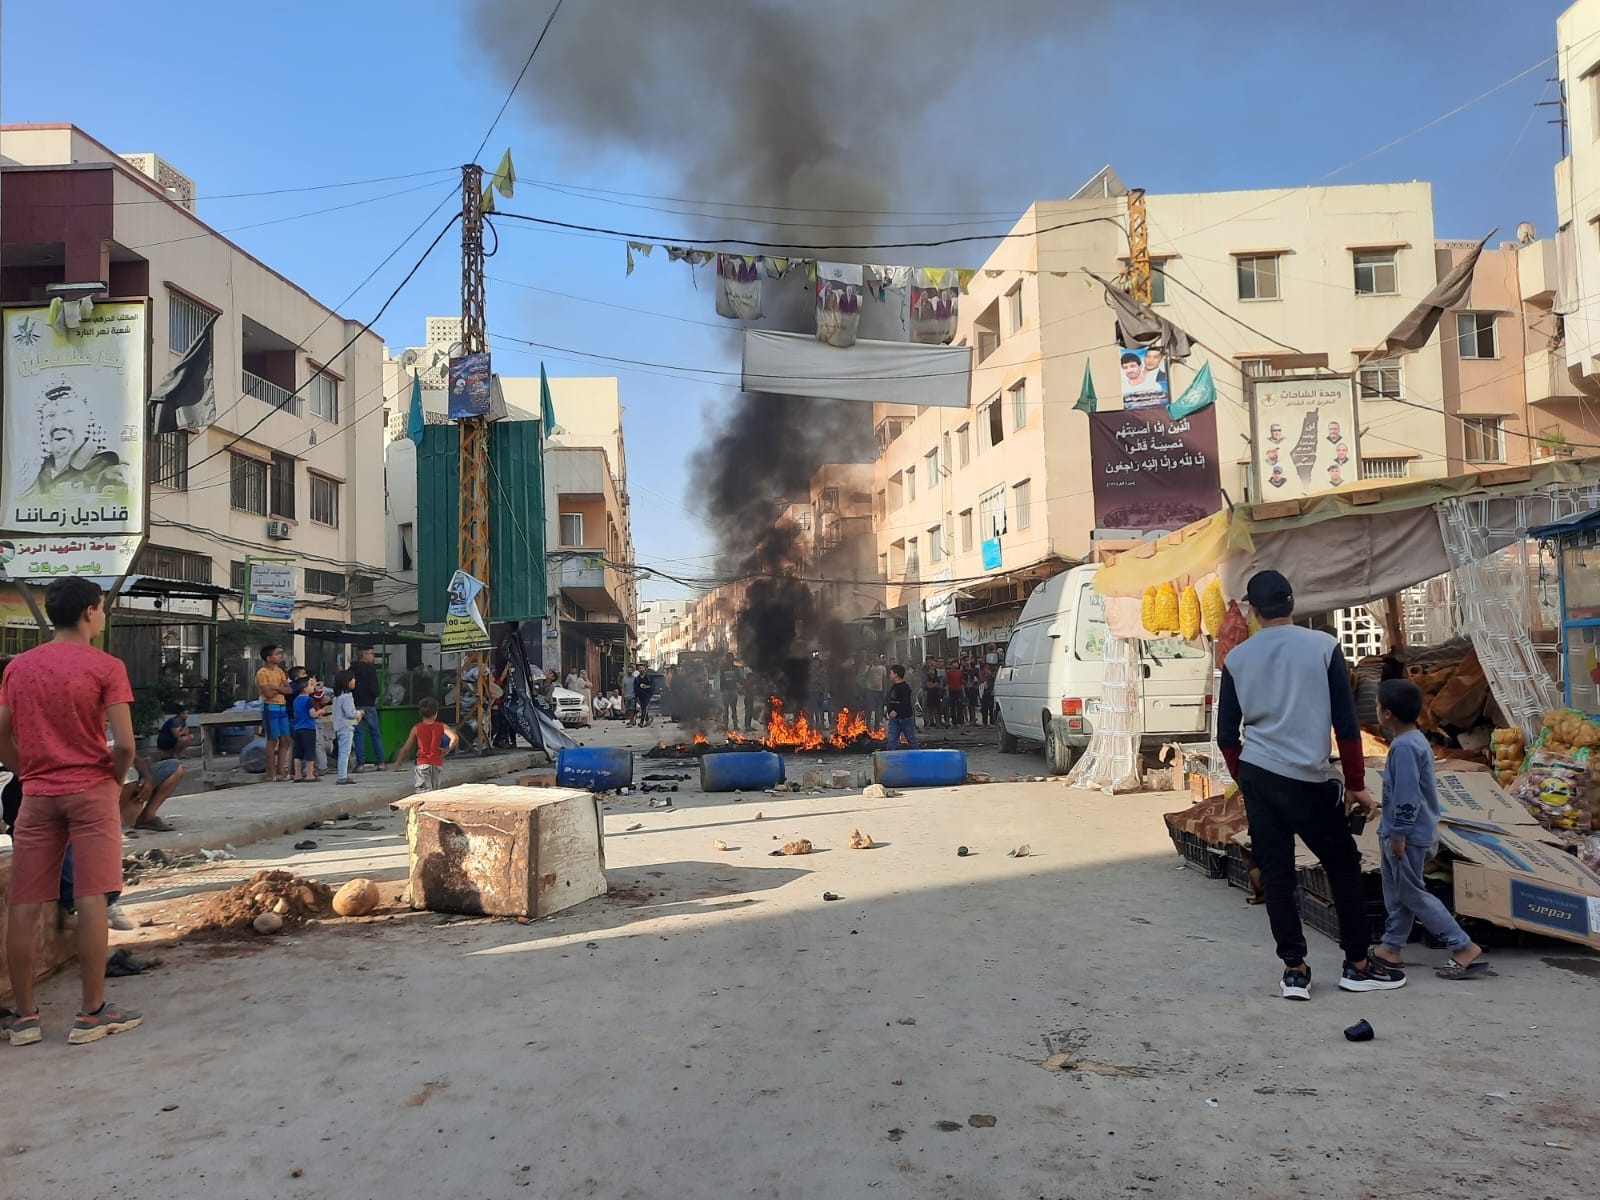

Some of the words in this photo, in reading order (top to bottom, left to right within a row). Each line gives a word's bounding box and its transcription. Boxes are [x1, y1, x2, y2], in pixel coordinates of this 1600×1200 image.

[15, 507, 66, 527] زماننا
[71, 506, 129, 526] قناديل
[17, 543, 47, 555] الرمز
[49, 541, 86, 554] الشهيد
[89, 541, 116, 551] ساحة
[28, 562, 70, 575] عرفات
[71, 561, 102, 575] ياسر
[1528, 903, 1572, 920] cedars
